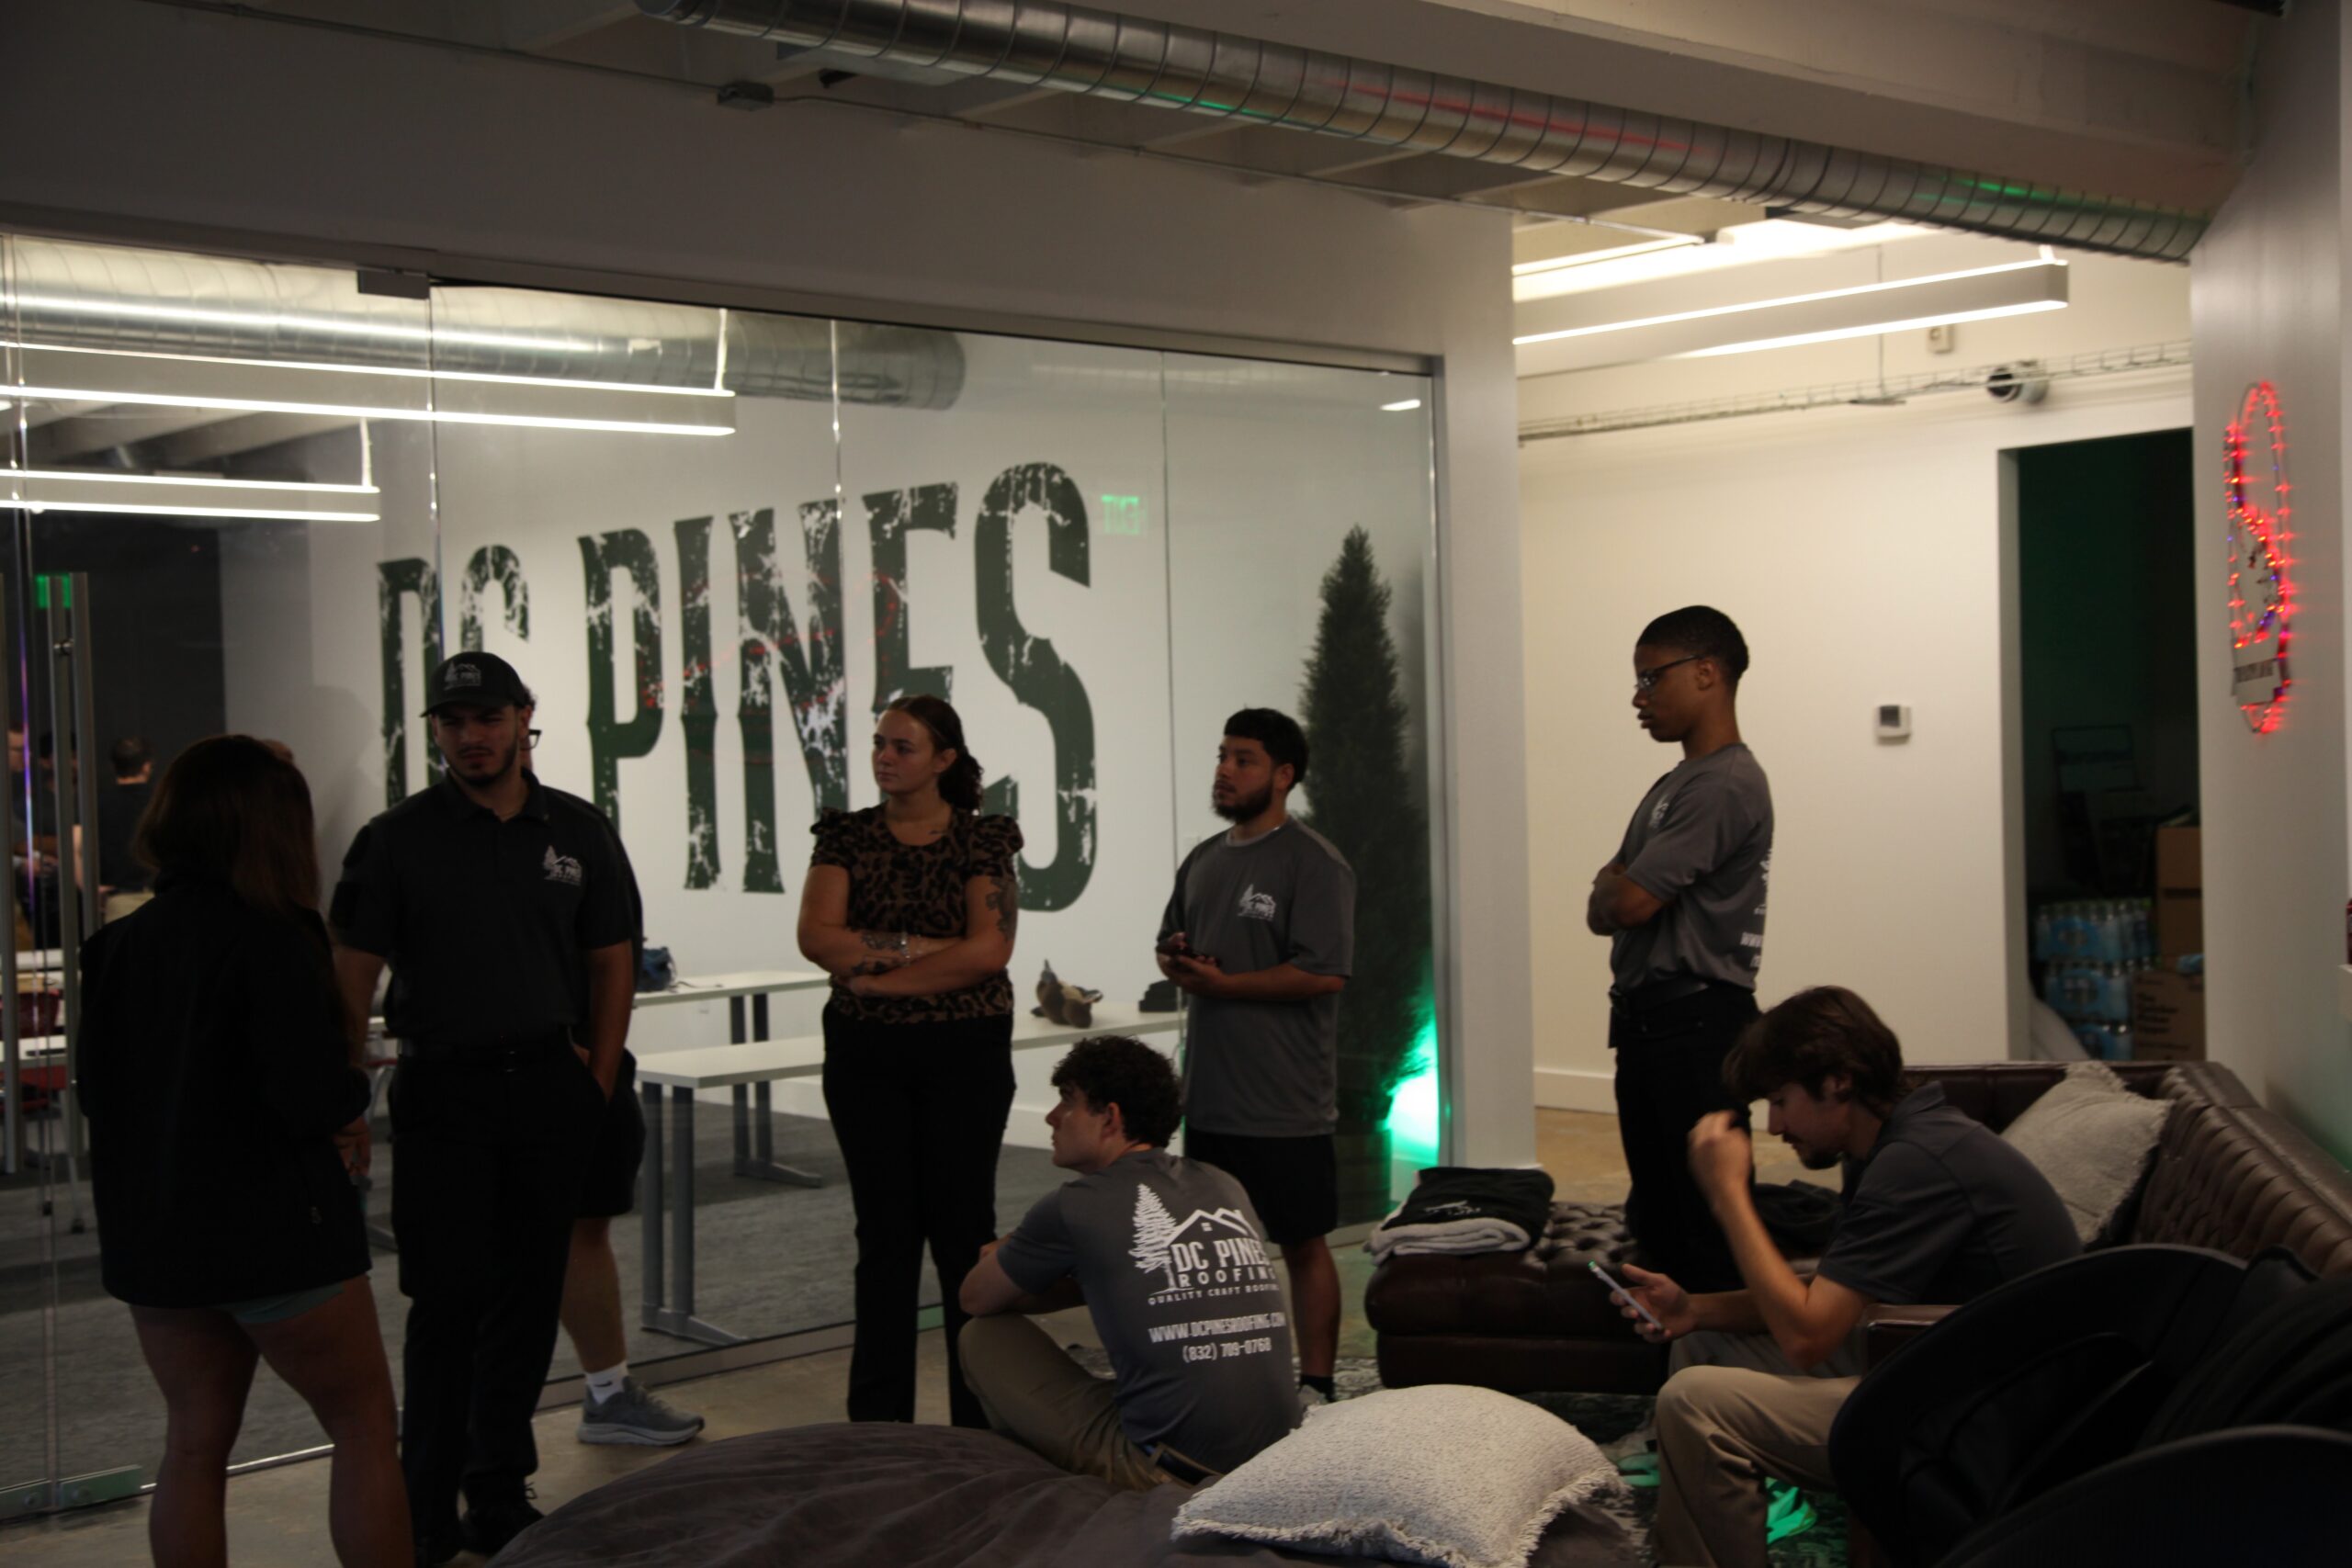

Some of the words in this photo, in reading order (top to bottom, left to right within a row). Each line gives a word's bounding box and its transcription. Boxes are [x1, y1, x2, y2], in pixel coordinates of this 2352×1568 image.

[579, 462, 1096, 911] PINES
[1170, 1241, 1209, 1273] DC
[1148, 1291, 1203, 1305] QUALITY
[1208, 1287, 1240, 1297] CRAFT
[1182, 1343, 1218, 1363] (832)
